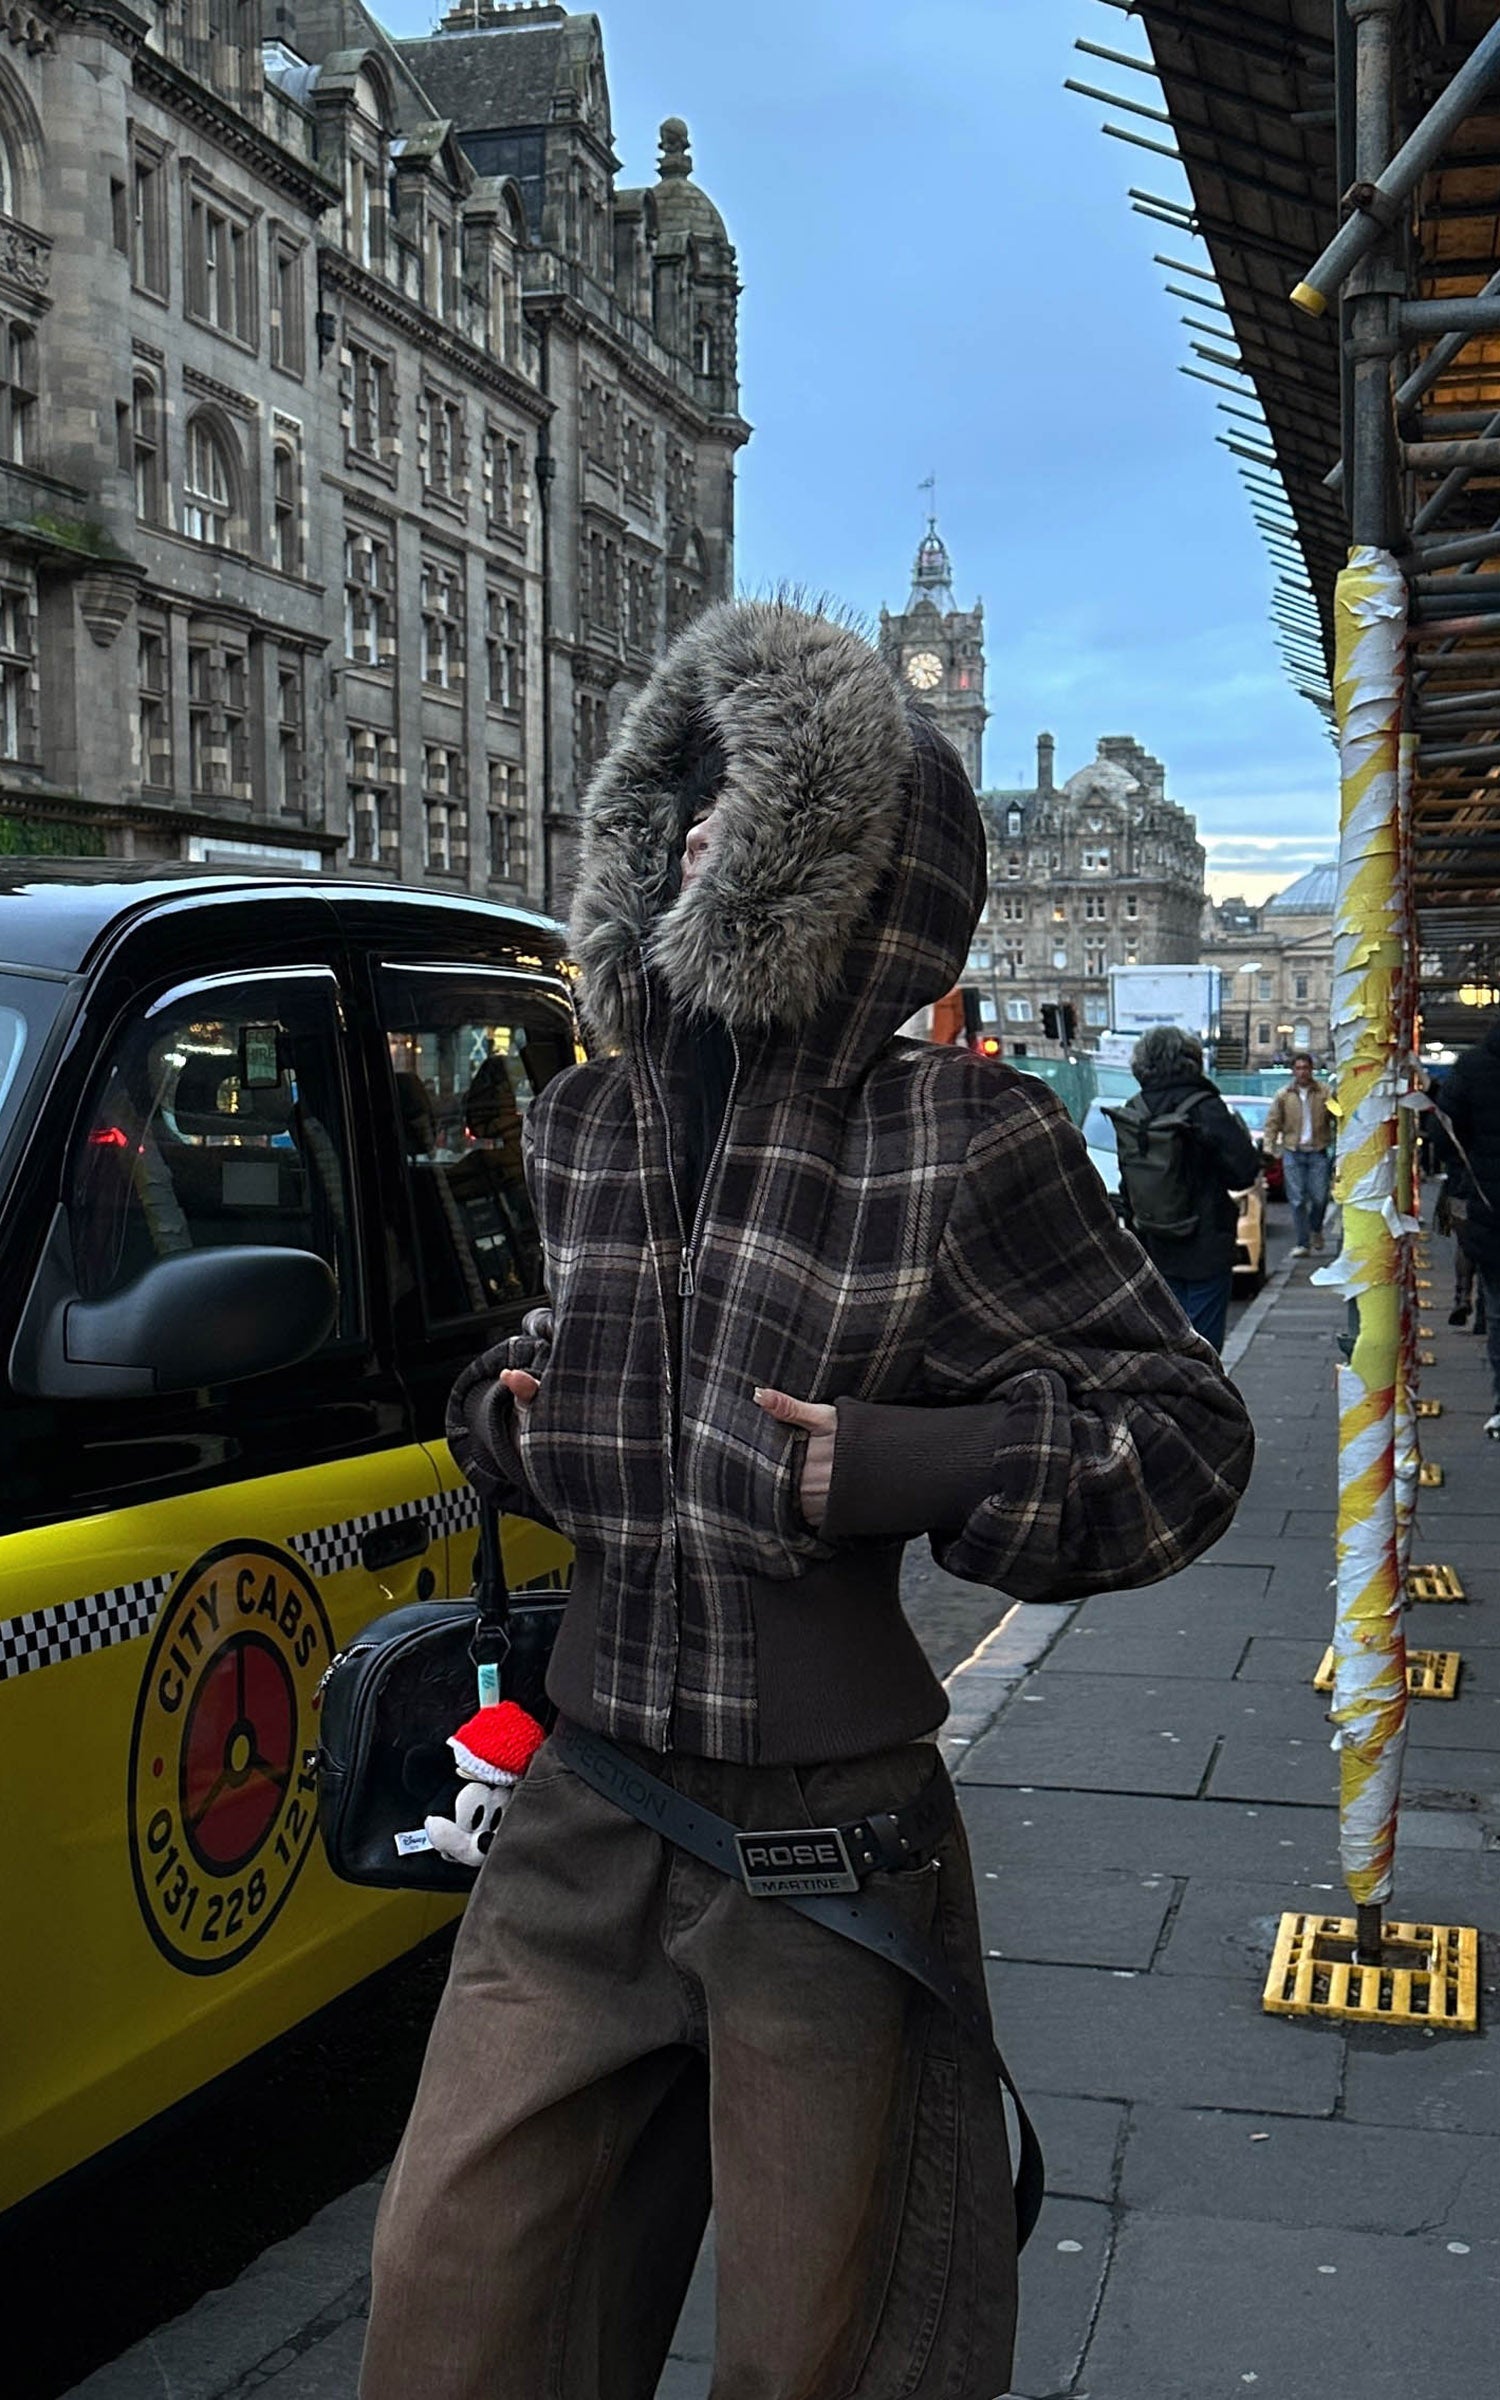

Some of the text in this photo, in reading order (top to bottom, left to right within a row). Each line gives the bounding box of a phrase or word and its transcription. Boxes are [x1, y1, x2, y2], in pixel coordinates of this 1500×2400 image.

[158, 1568, 317, 1713] CITY CABS
[399, 1834, 427, 1847] Disney
[746, 1844, 839, 1868] ROSE
[148, 1808, 199, 1932] 0131
[201, 1868, 268, 1942] 228
[761, 1877, 840, 1892] MARTINE
